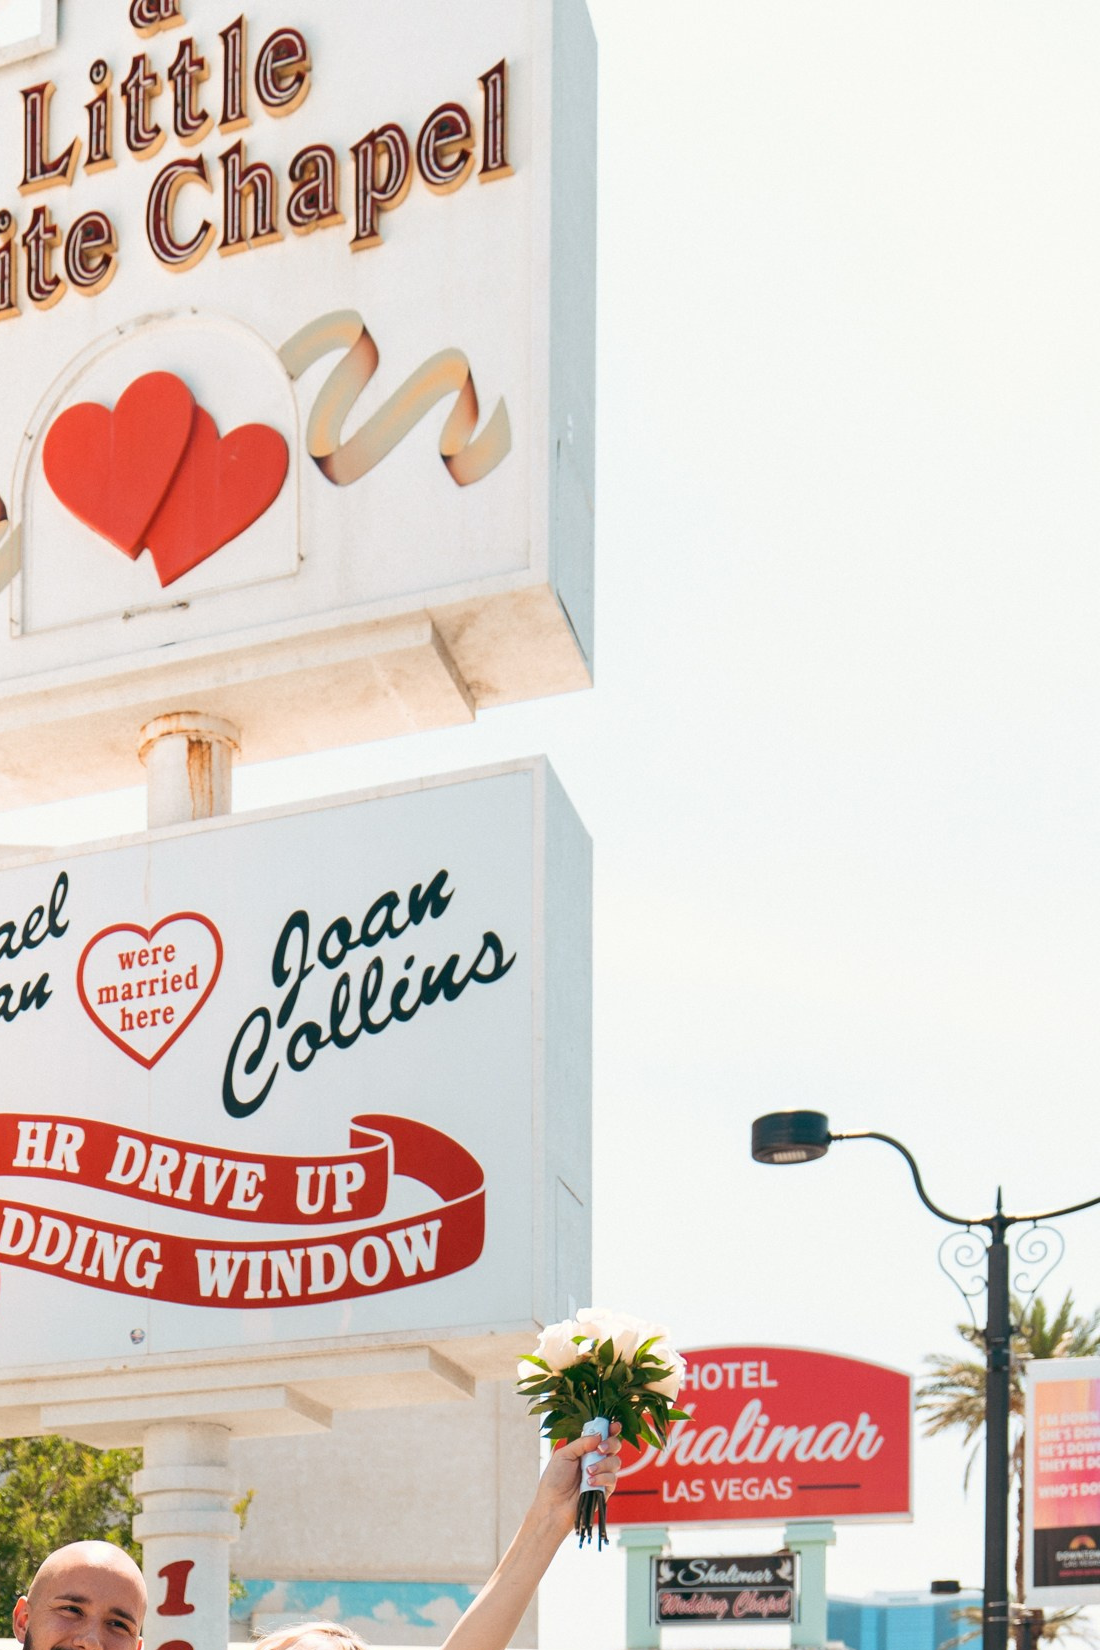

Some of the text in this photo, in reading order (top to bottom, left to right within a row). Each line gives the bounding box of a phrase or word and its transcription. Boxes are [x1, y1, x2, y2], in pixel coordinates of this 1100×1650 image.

[17, 13, 312, 197] Little
[146, 57, 515, 274] Chapel
[118, 941, 177, 971] were
[272, 868, 456, 1029] Joan
[97, 965, 200, 1006] married
[119, 1003, 175, 1032] here
[222, 930, 517, 1119] Collins
[14, 1120, 85, 1175] HR
[105, 1135, 267, 1212] DRIVE
[295, 1162, 366, 1214] UP
[195, 1219, 444, 1301] WINDOW
[682, 1361, 778, 1391] HOTEL
[662, 1476, 793, 1503] LAS VEGAS
[677, 1559, 774, 1586] Shalimar
[659, 1589, 790, 1621] Wedding Chapel
